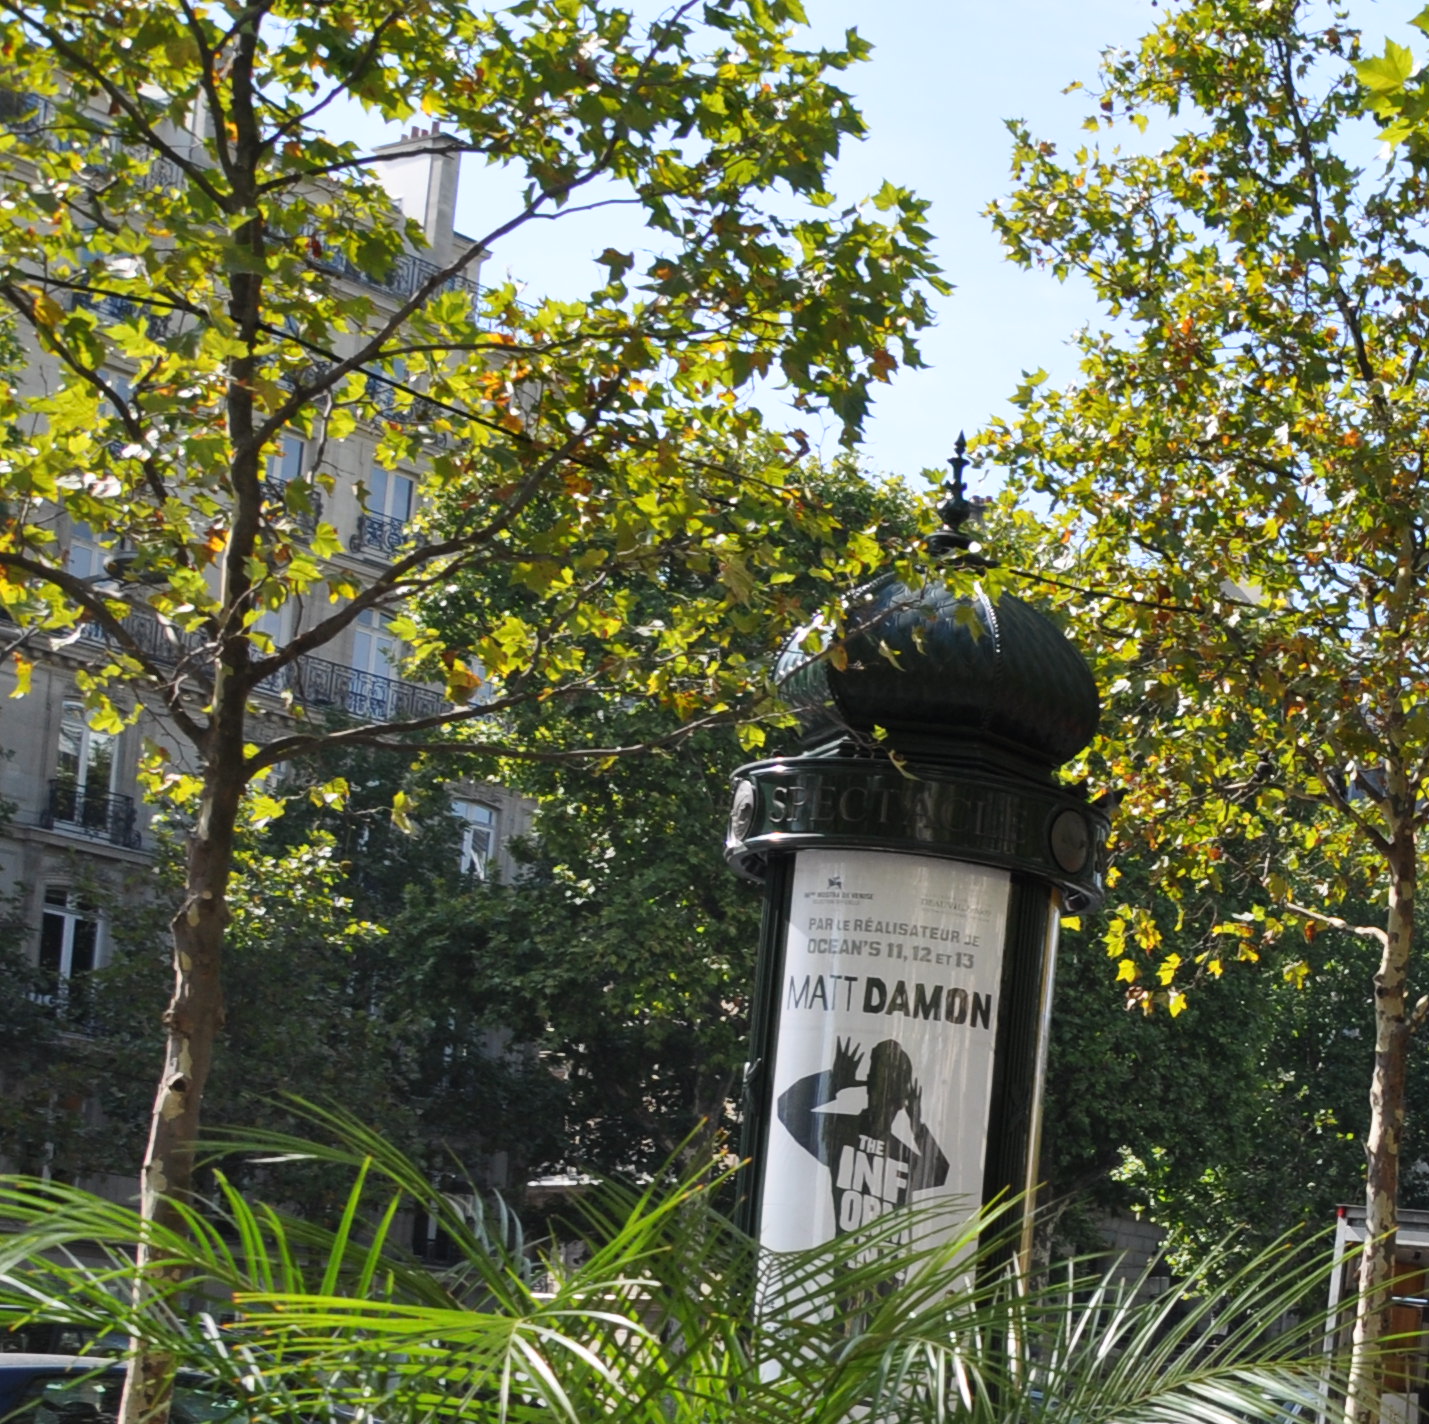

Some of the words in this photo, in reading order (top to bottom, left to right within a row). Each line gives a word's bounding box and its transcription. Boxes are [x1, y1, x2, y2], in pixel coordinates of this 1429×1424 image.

[808, 917, 833, 931] PAR
[836, 919, 850, 931] LE
[854, 916, 960, 943] RÉALISATEUR
[807, 938, 881, 957] OCEAN'S
[887, 942, 908, 962] 11,
[912, 945, 931, 963] 12
[935, 953, 952, 966] ET
[955, 951, 975, 969] 13
[786, 974, 858, 1012] MATT
[862, 976, 992, 1030] DAMON
[858, 1134, 885, 1156] THE
[836, 1145, 909, 1204] INF
